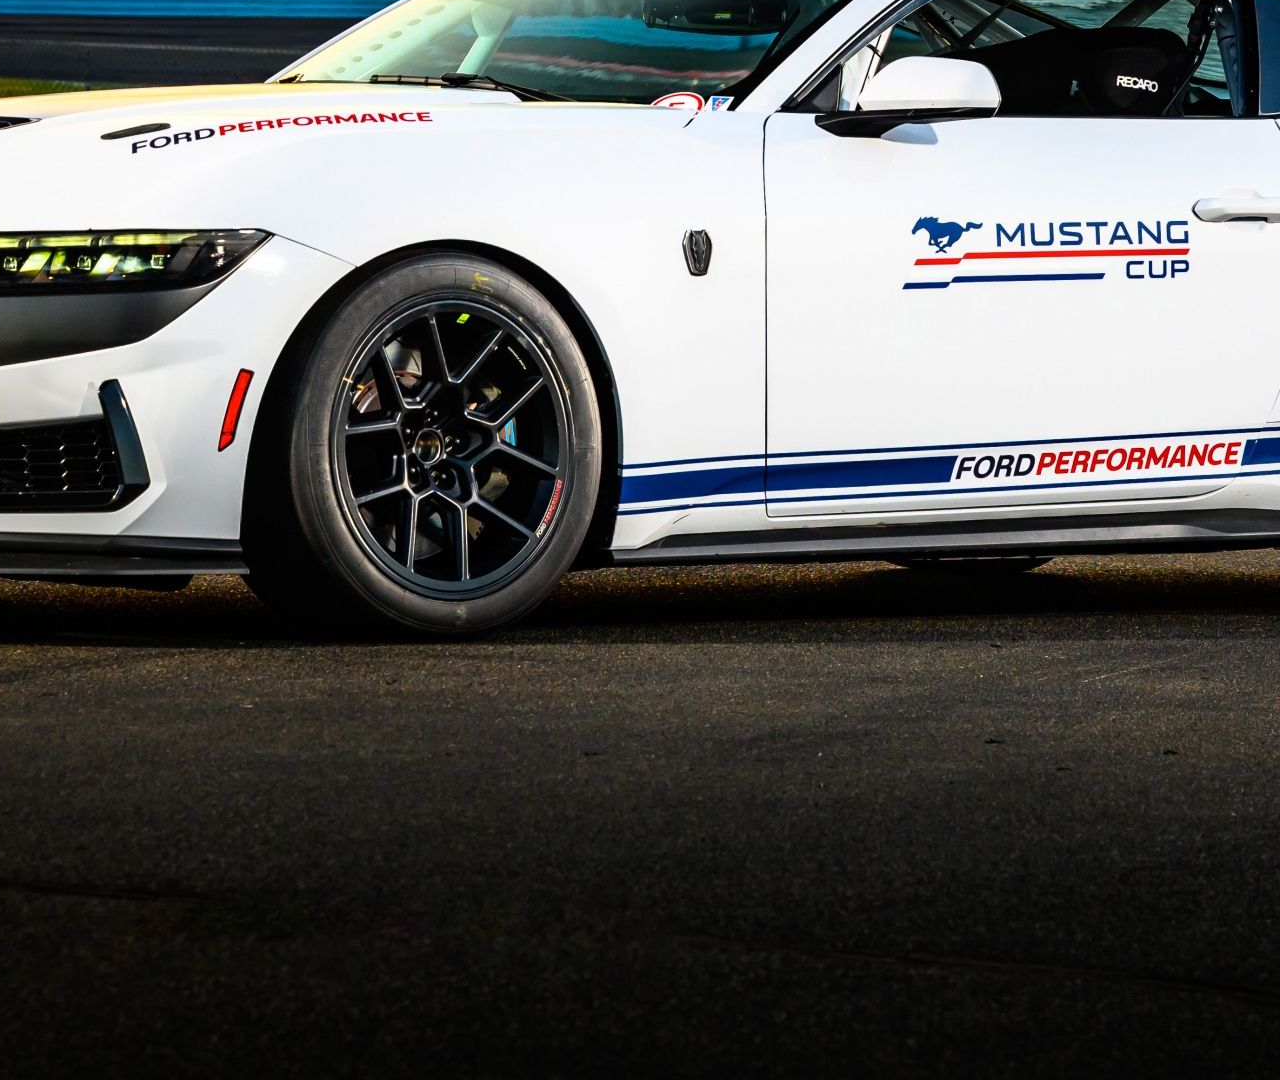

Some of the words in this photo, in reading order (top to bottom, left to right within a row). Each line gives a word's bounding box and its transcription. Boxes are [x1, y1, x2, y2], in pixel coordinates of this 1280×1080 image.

[1116, 75, 1159, 93] RECARO
[995, 220, 1190, 248] MUSTANG
[1125, 260, 1190, 280] CUP
